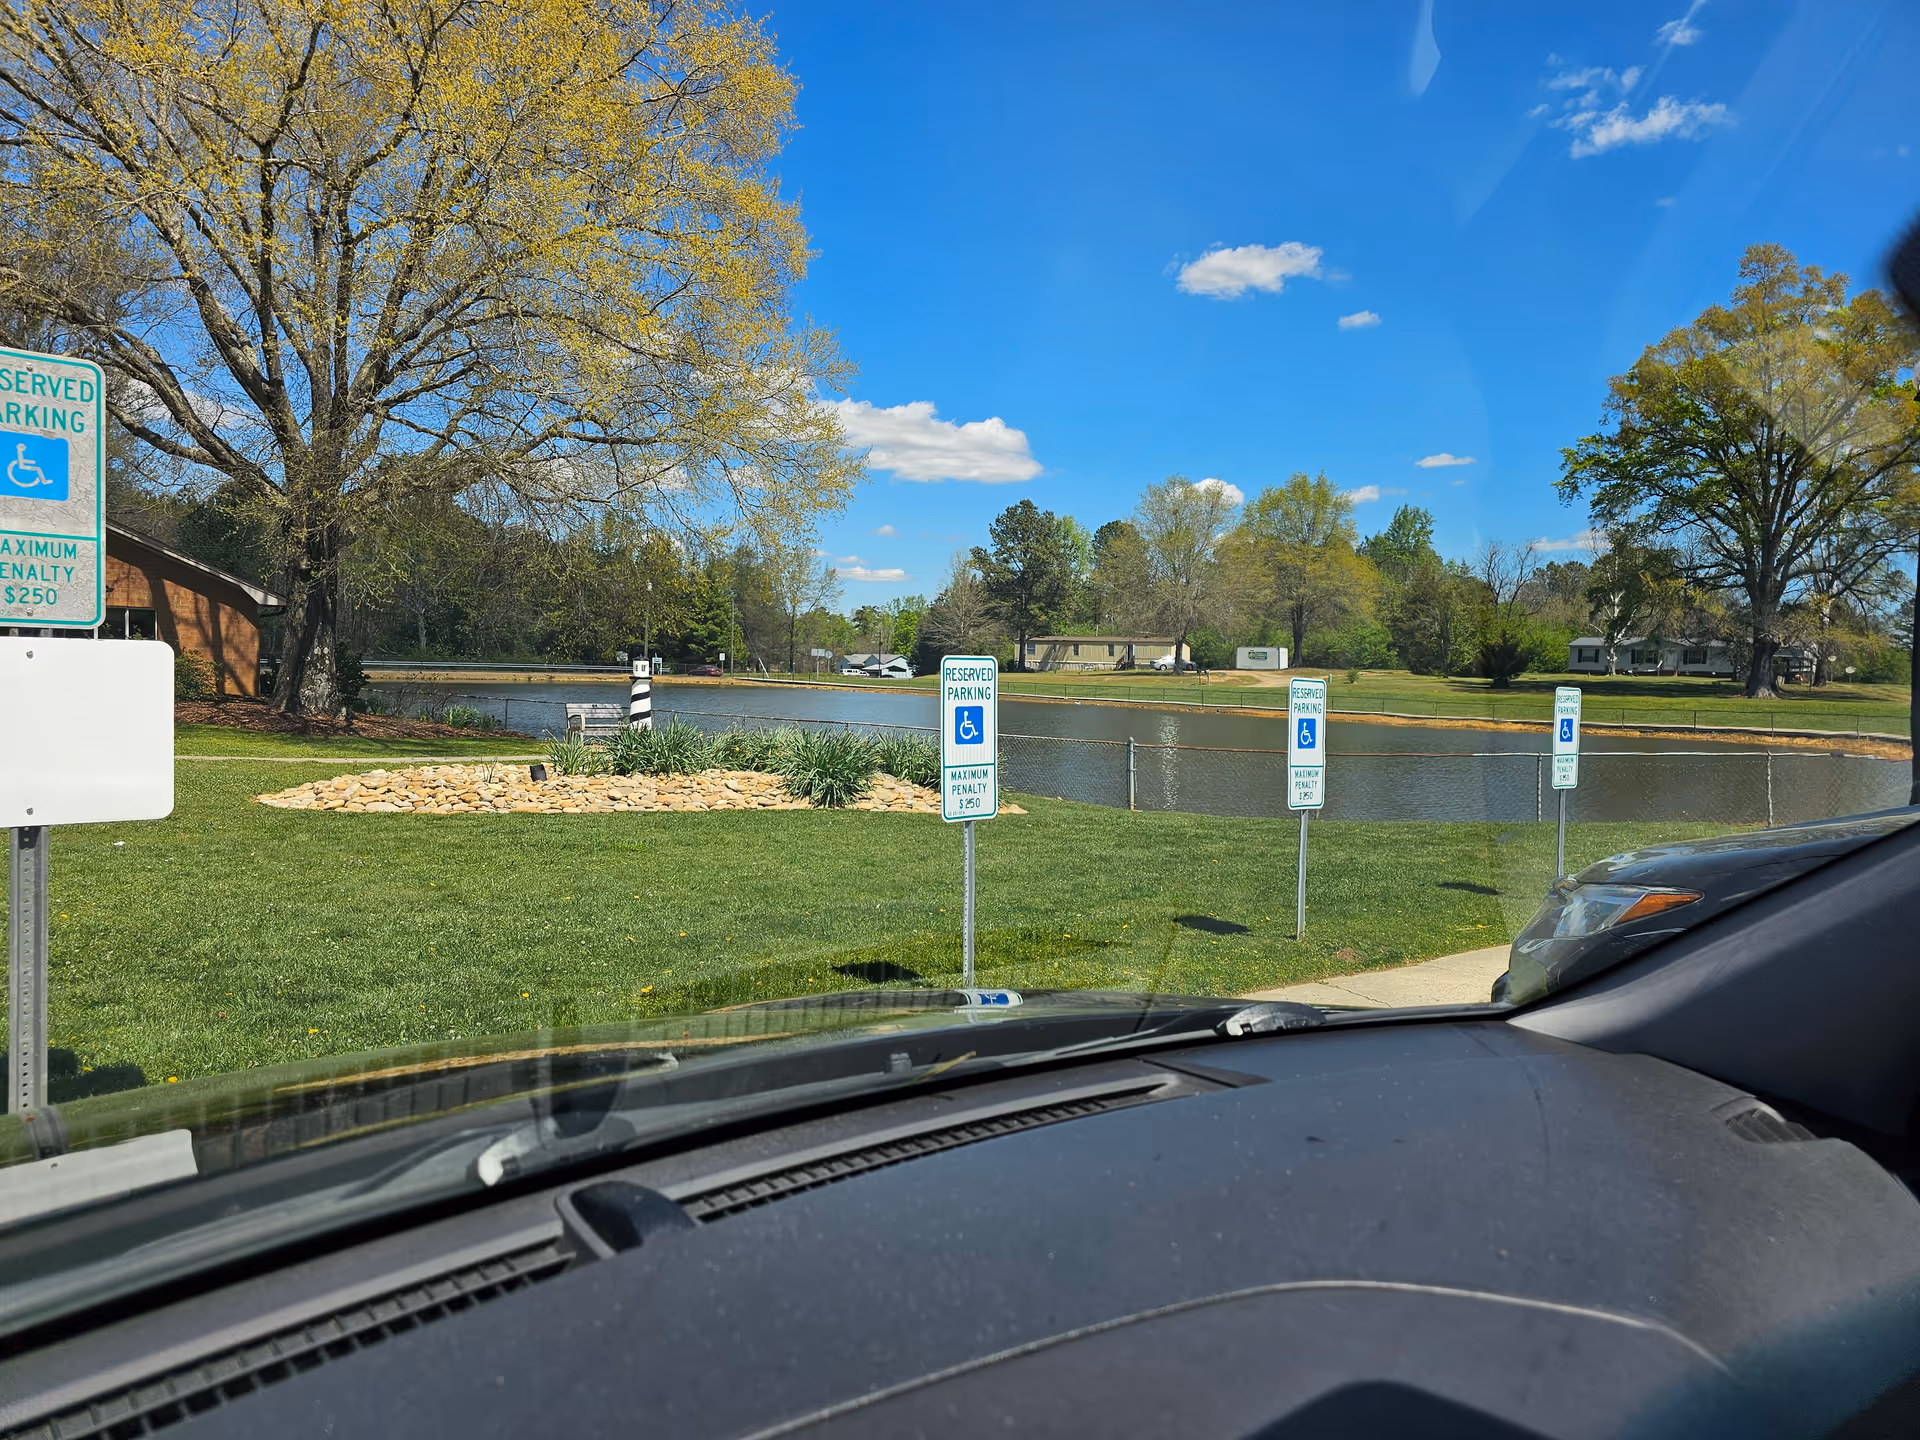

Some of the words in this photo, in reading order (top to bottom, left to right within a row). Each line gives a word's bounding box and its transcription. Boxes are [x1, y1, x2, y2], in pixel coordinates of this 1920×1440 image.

[0, 368, 94, 402] SERVED
[0, 538, 77, 560] AXIMUM
[0, 562, 75, 583] ENALTY
[5, 585, 58, 606] $250
[945, 667, 994, 682] RESERVED
[948, 686, 991, 701] PARKING
[1292, 687, 1324, 699] RESERVED
[1293, 702, 1322, 714] PARKING
[951, 768, 989, 781] MAXIMUM
[952, 782, 987, 796] PENALTY
[1295, 780, 1318, 789] PENALTY
[959, 797, 981, 810] $250
